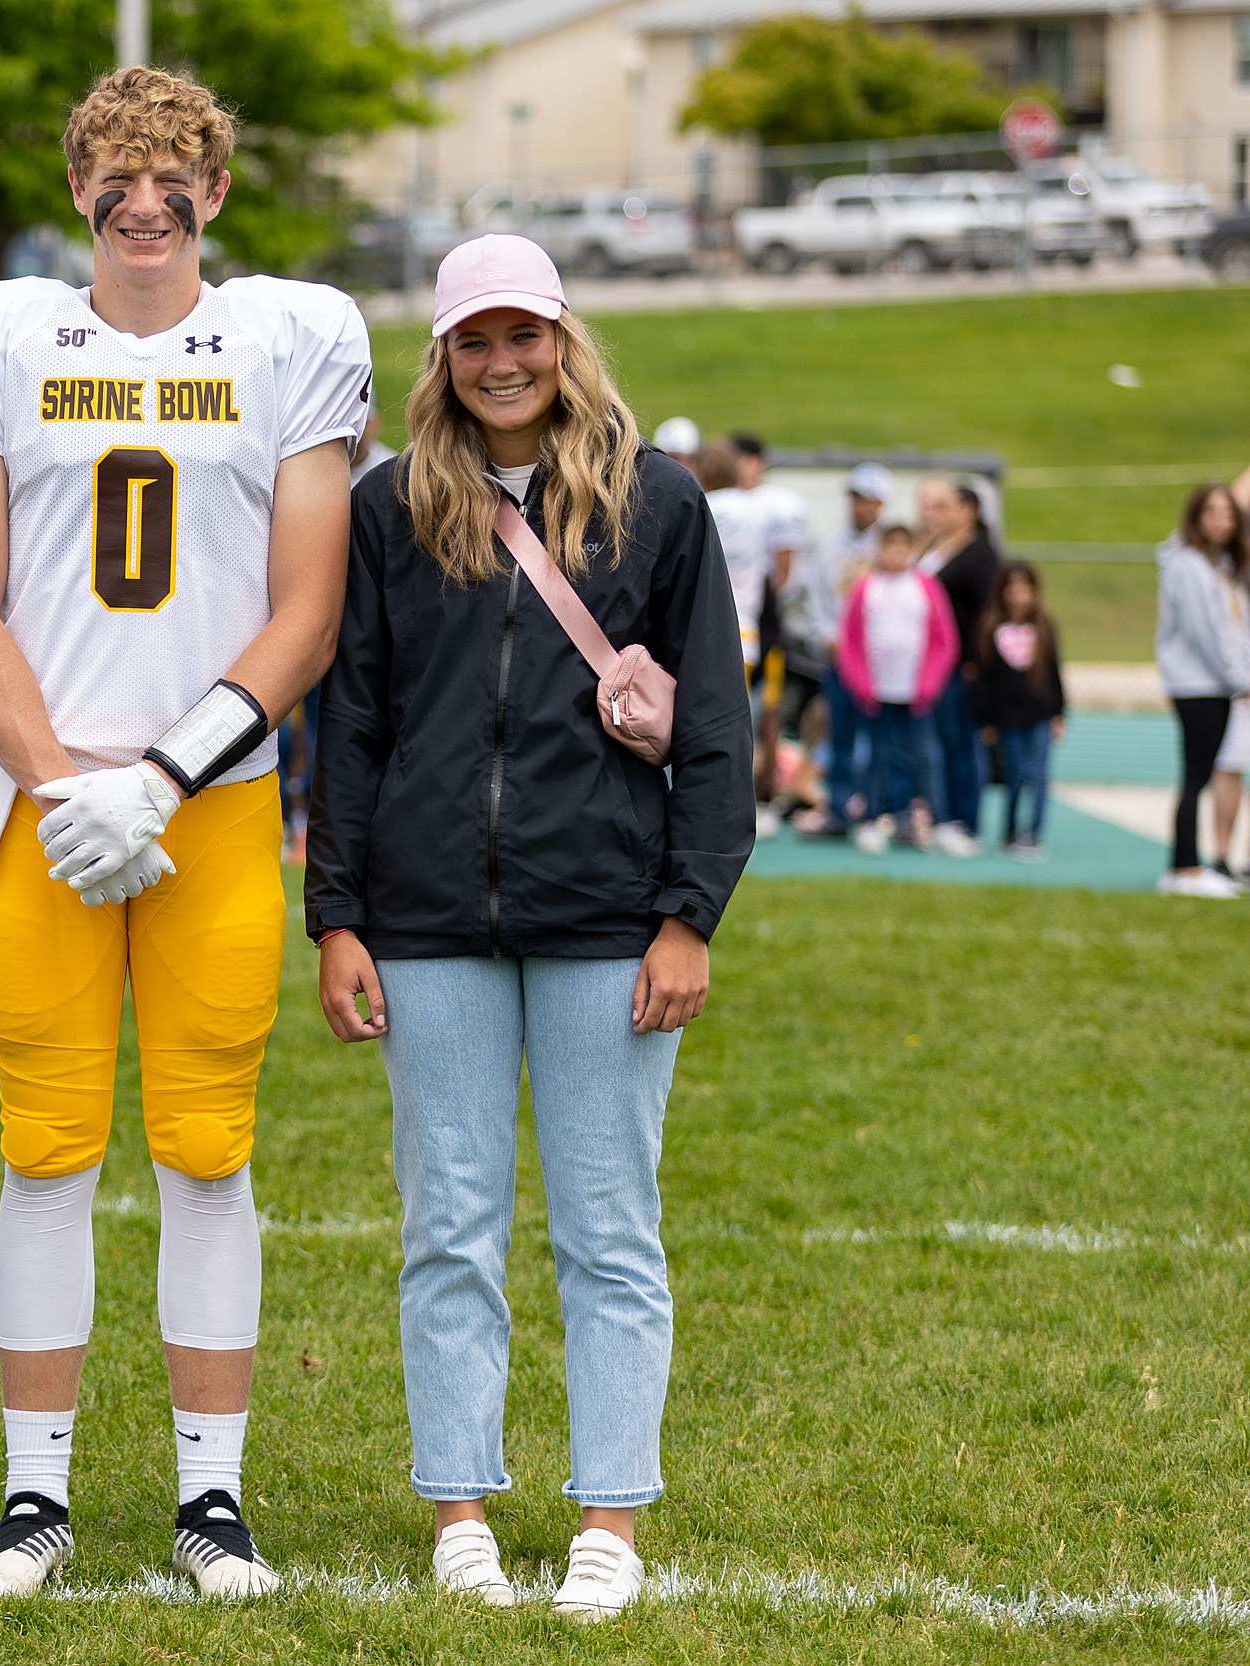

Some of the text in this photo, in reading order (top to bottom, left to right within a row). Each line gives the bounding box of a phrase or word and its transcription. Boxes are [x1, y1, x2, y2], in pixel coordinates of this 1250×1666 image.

[40, 377, 241, 424] SHRINE BOWL
[90, 444, 178, 613] 0
